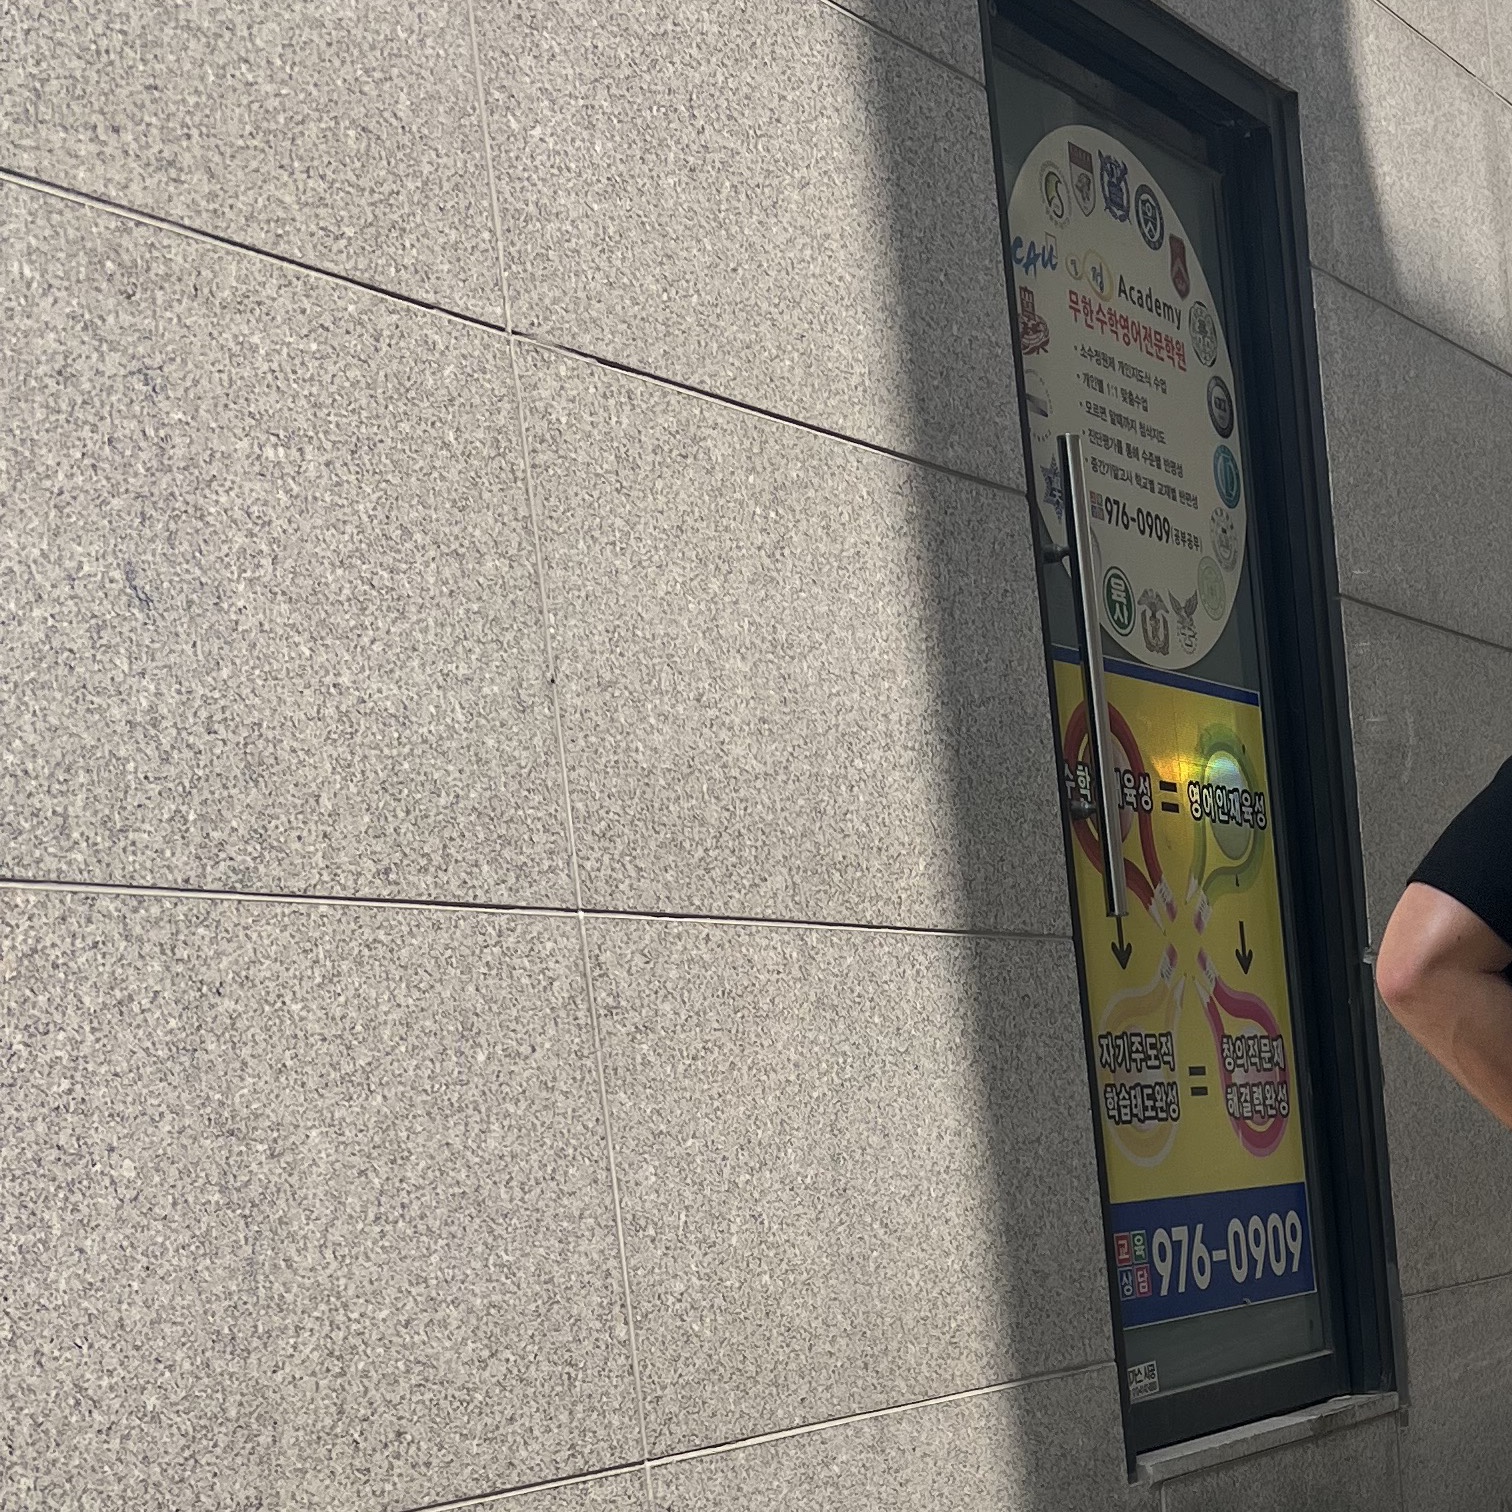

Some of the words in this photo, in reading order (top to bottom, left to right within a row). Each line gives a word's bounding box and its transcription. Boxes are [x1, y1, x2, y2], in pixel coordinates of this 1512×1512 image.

[1118, 274, 1182, 331] Academy
[1068, 289, 1187, 372] 무한수학영어전문학원
[1153, 375, 1168, 395] 수업
[1104, 496, 1171, 544] 976-0909
[1187, 780, 1267, 830] 영어인재육성
[1099, 1031, 1175, 1073] 자기주도적
[1221, 1034, 1287, 1073] 창의적문제
[1104, 1082, 1181, 1125] 학습태도완성
[1226, 1083, 1290, 1120] 해결력완성
[1152, 1210, 1302, 1297] 976-0909
